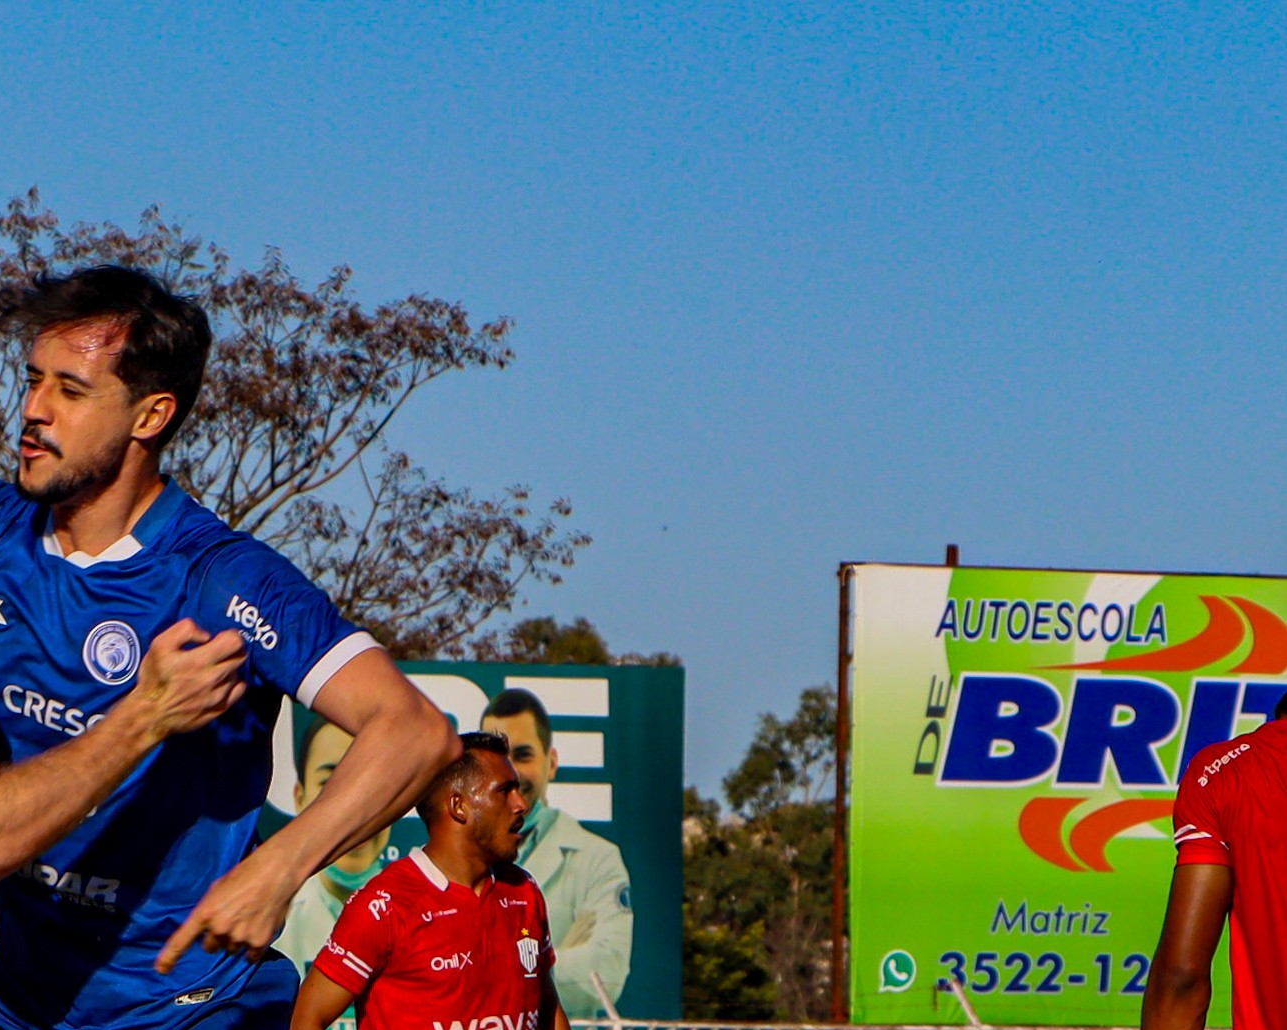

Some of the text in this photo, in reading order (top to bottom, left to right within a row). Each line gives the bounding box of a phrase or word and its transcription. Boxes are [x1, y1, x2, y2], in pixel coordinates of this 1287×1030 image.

[936, 599, 1167, 644] AUTOESCOLA
[913, 674, 954, 776] DE
[990, 900, 1111, 936] Matriz
